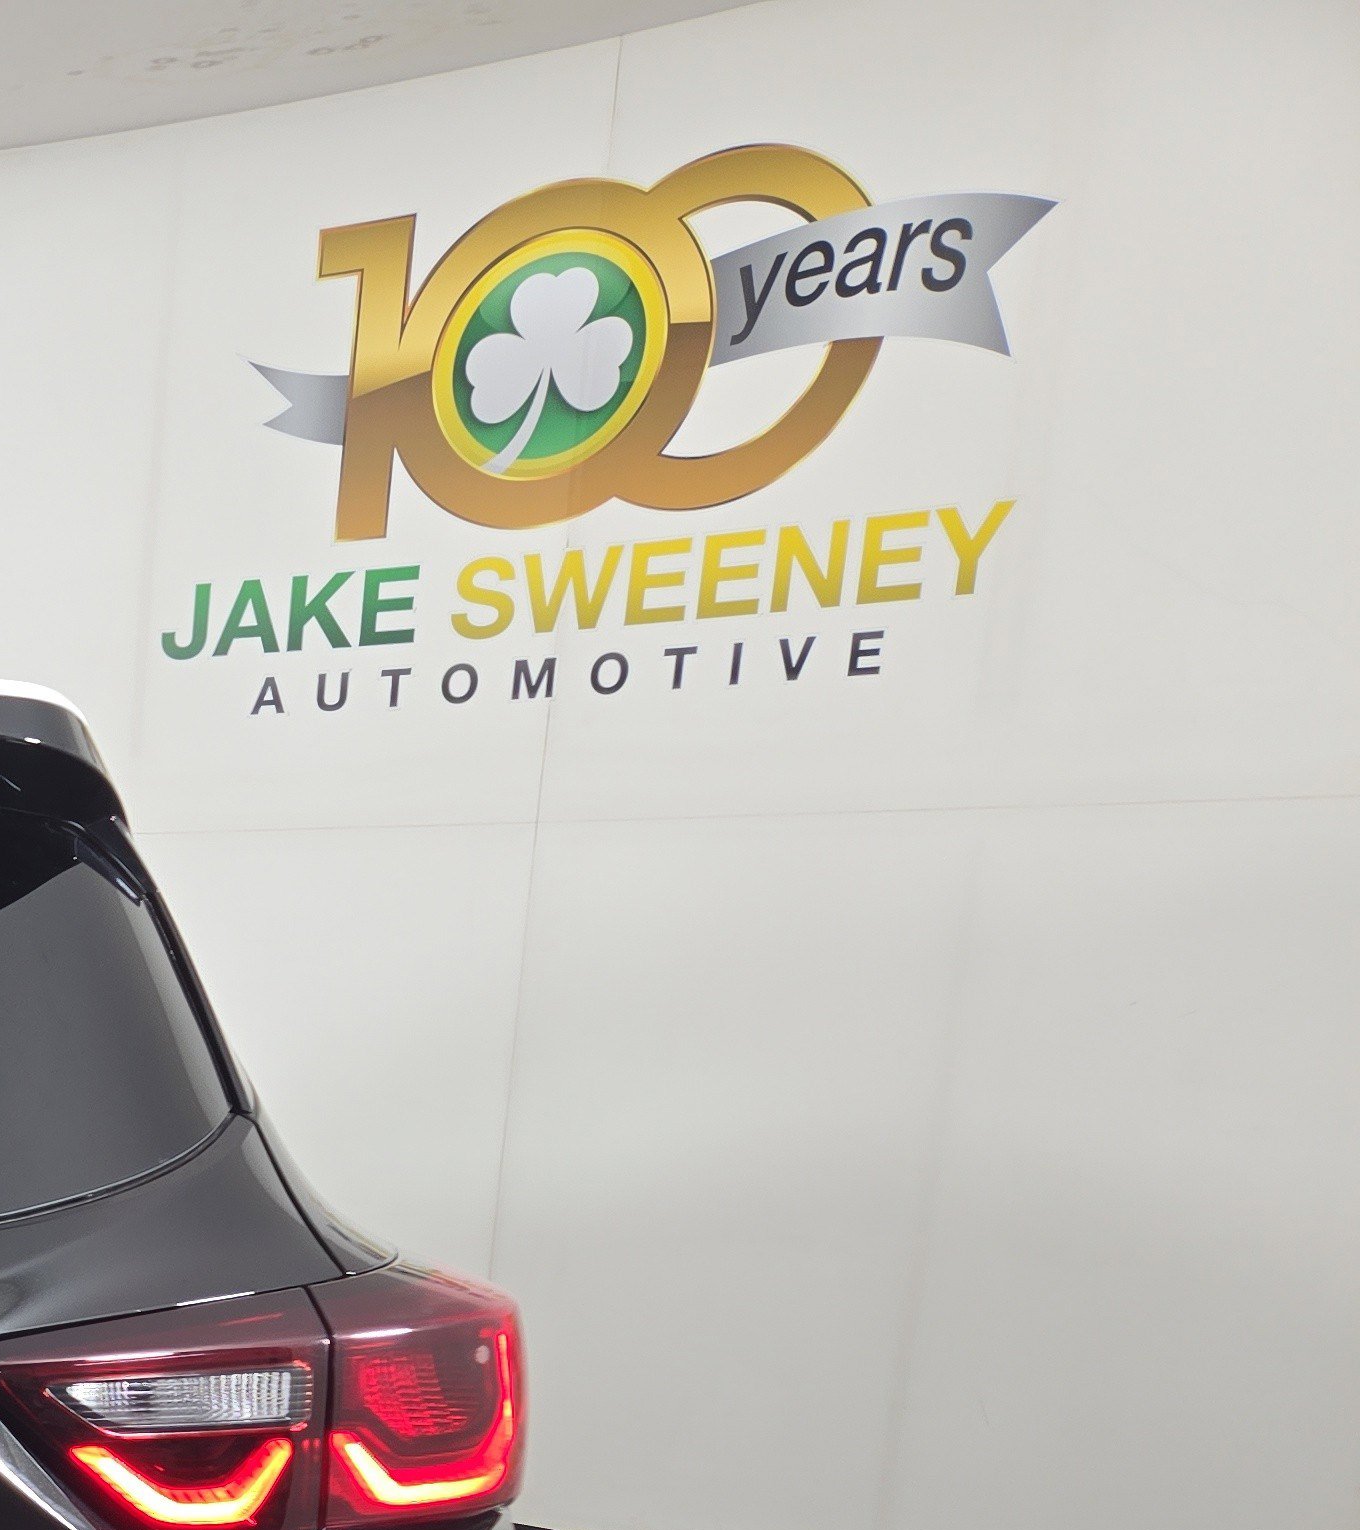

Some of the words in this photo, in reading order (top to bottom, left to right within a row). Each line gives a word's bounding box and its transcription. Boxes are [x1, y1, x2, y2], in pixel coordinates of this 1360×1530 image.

[314, 142, 886, 546] 100
[728, 216, 974, 348] years
[160, 564, 422, 662] JAKE
[450, 500, 1018, 640] SWEENEY
[250, 630, 886, 716] AUTOMOTIVE
